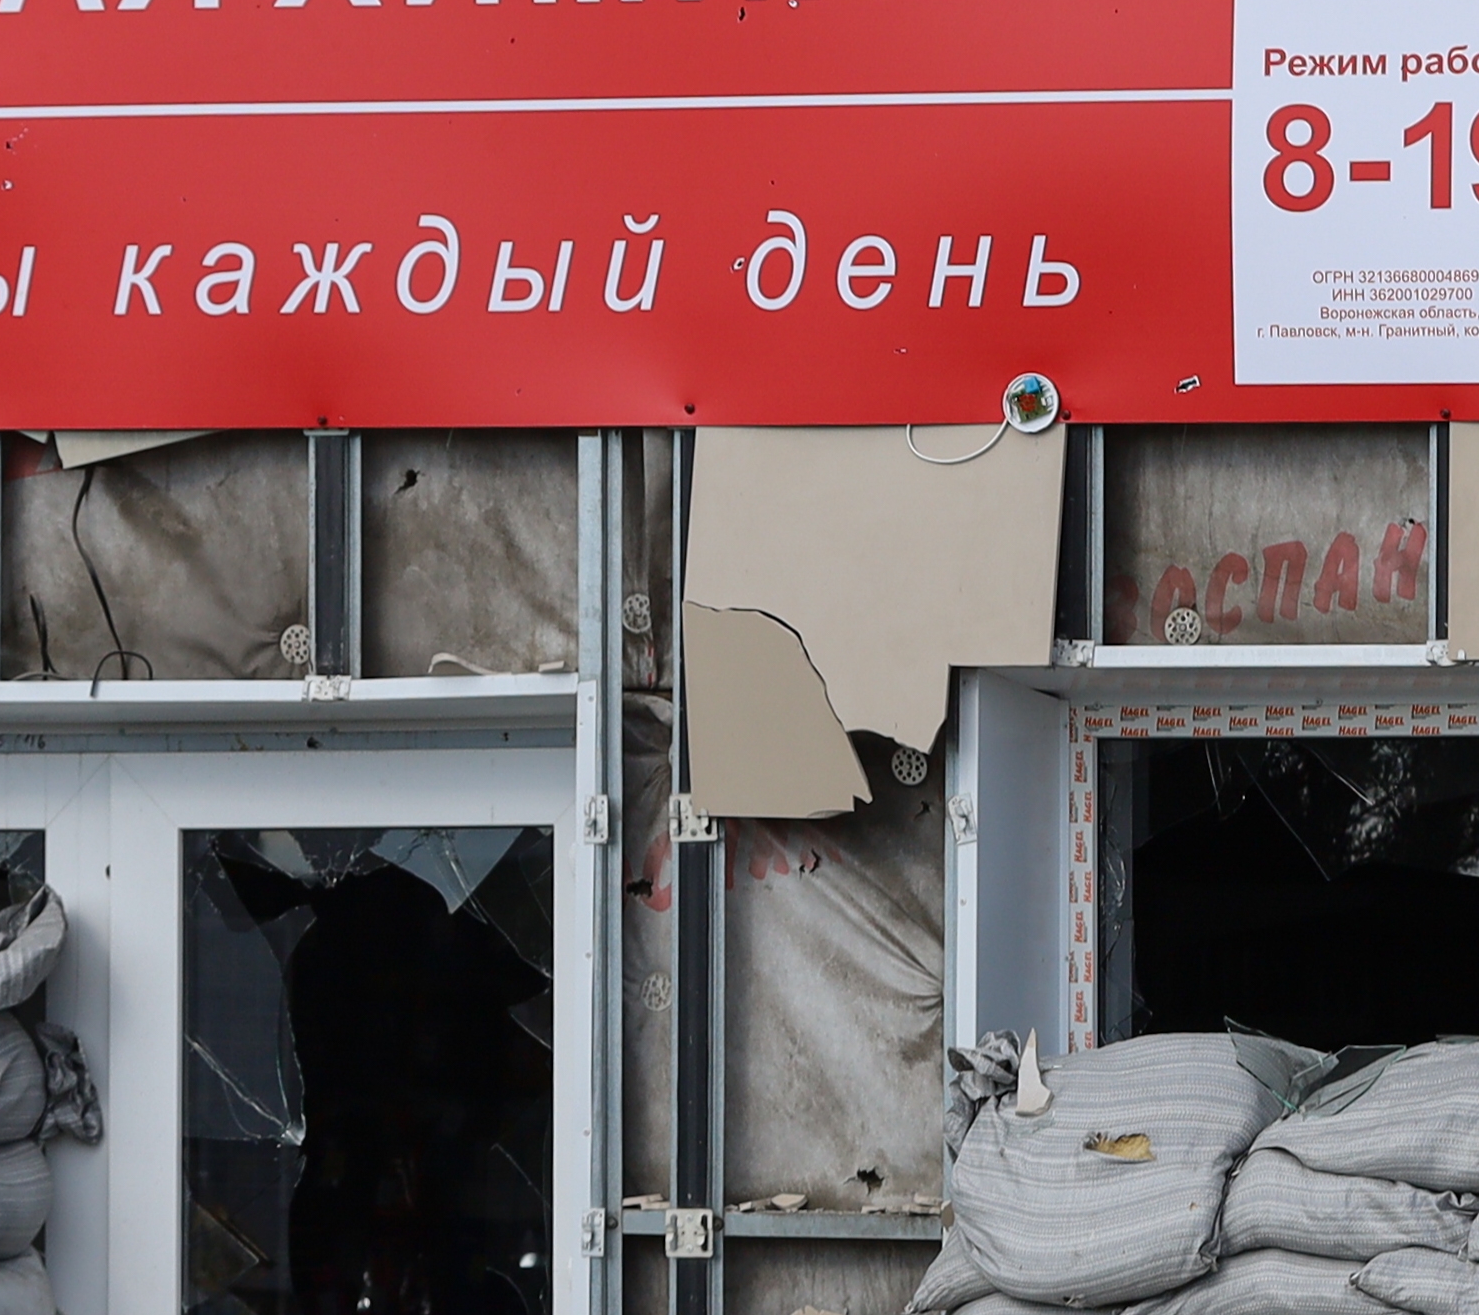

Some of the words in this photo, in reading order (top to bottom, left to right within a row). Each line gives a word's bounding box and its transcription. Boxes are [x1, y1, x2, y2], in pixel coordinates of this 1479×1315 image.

[1262, 47, 1388, 77] Режим
[114, 214, 665, 316] каждый
[745, 210, 1081, 311] день
[1312, 269, 1355, 285] ОГРН
[1331, 287, 1366, 302] ИНН
[1369, 287, 1474, 302] 362001029700
[1319, 305, 1416, 325] Воронежская
[1269, 323, 1342, 340] Павловск,
[1378, 322, 1460, 341] Гранитный,
[1121, 707, 1149, 717] HAGEL
[1193, 707, 1221, 717] HAGEL
[1266, 706, 1294, 716] HAGEL
[1339, 706, 1367, 715] HAGEL
[1411, 705, 1440, 715] HAGEL
[1085, 718, 1113, 727] HAGEL
[1157, 717, 1186, 727] HAGEL
[1230, 717, 1258, 726] HAGEL
[1302, 716, 1331, 726] HAGEL
[1376, 716, 1404, 726] HAGEL
[1448, 715, 1477, 725] HAGEL
